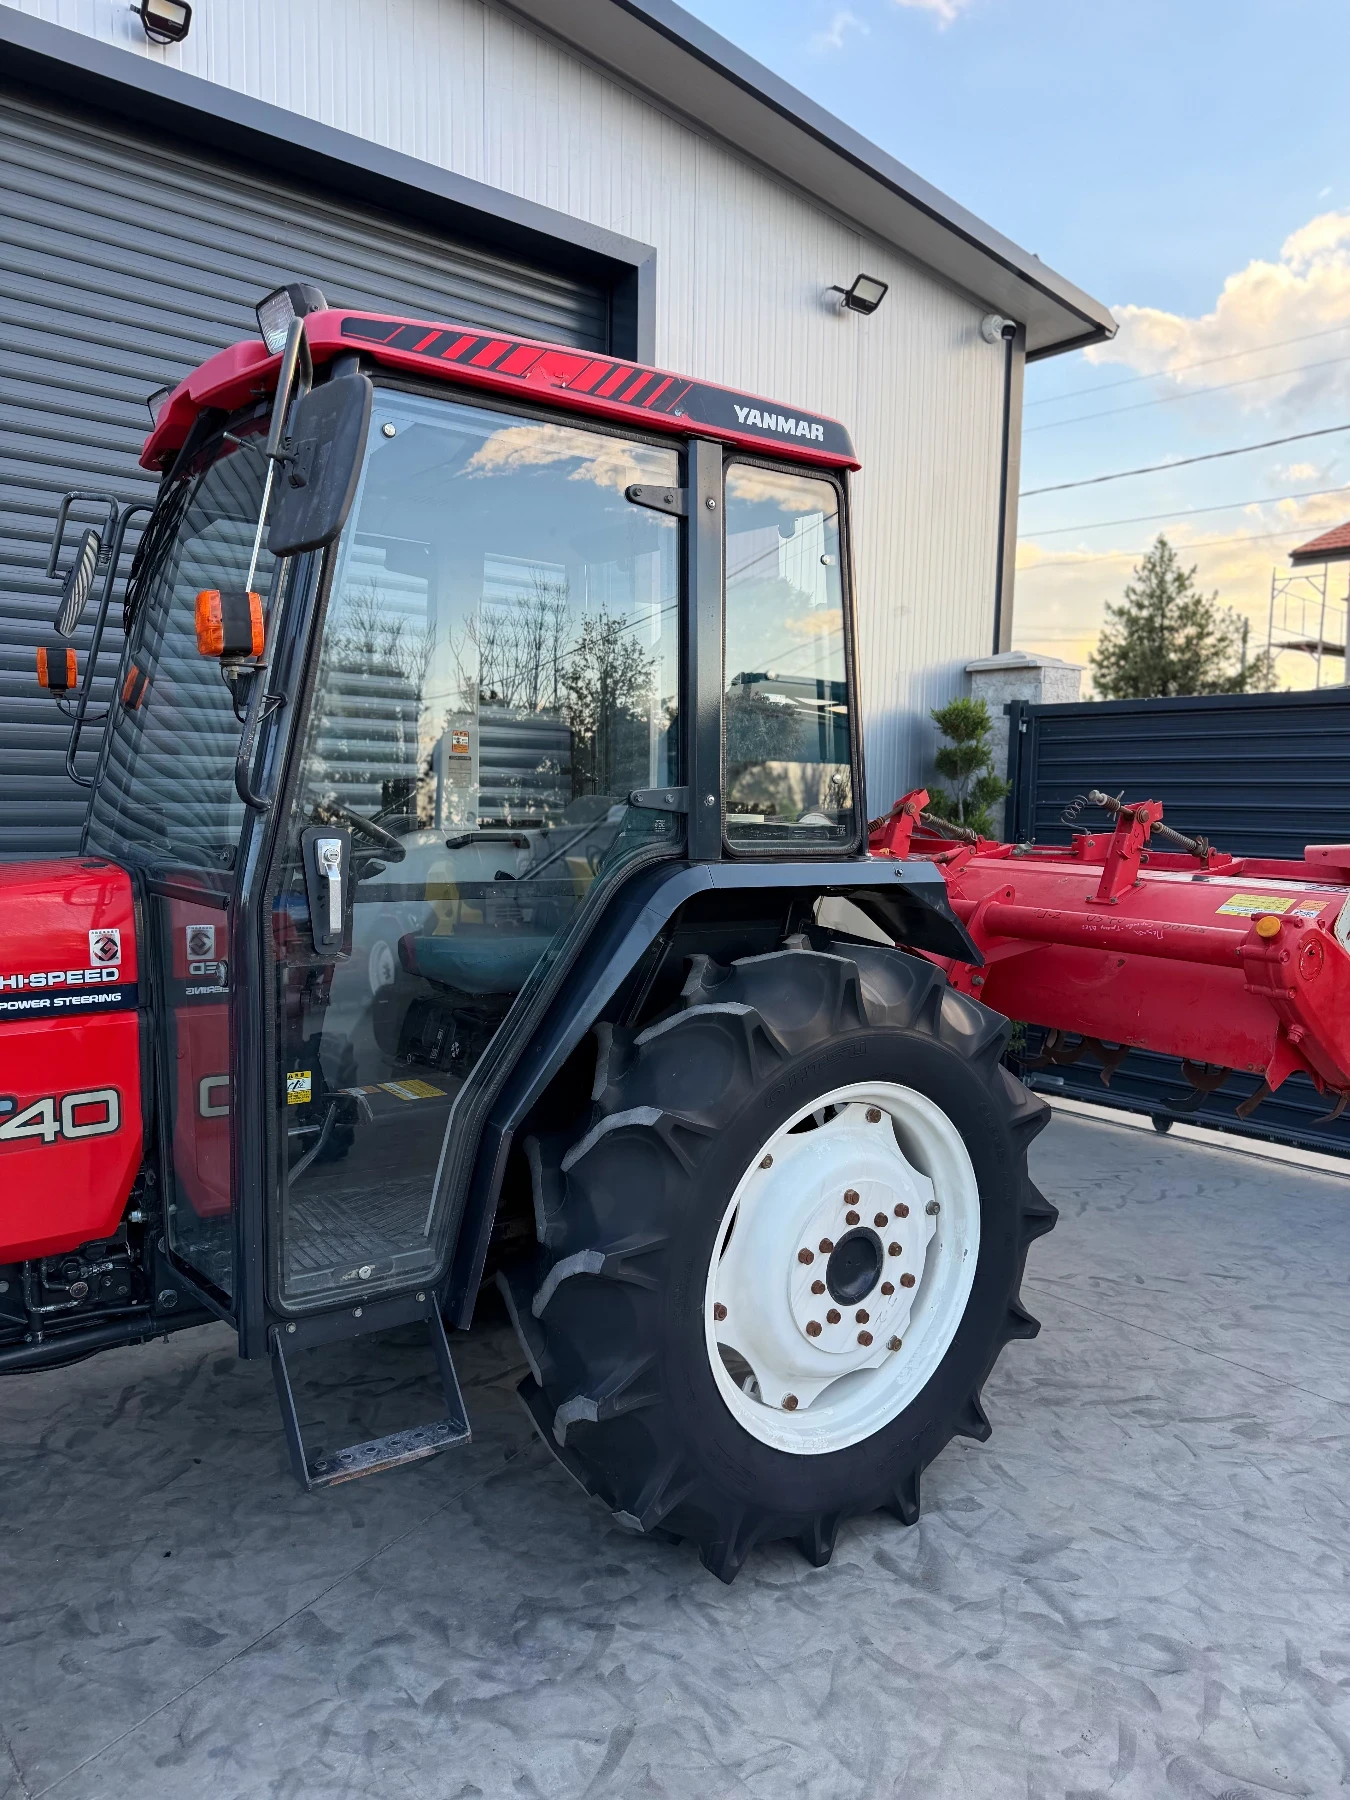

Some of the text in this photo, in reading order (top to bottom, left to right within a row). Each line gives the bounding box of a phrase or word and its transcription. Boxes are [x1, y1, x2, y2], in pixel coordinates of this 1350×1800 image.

[733, 404, 825, 442] YANMAR
[0, 967, 119, 990] HI-SPEED
[0, 993, 122, 1011] POWER STEERING
[764, 1041, 868, 1108] OHTSU
[0, 1088, 120, 1142] 40
